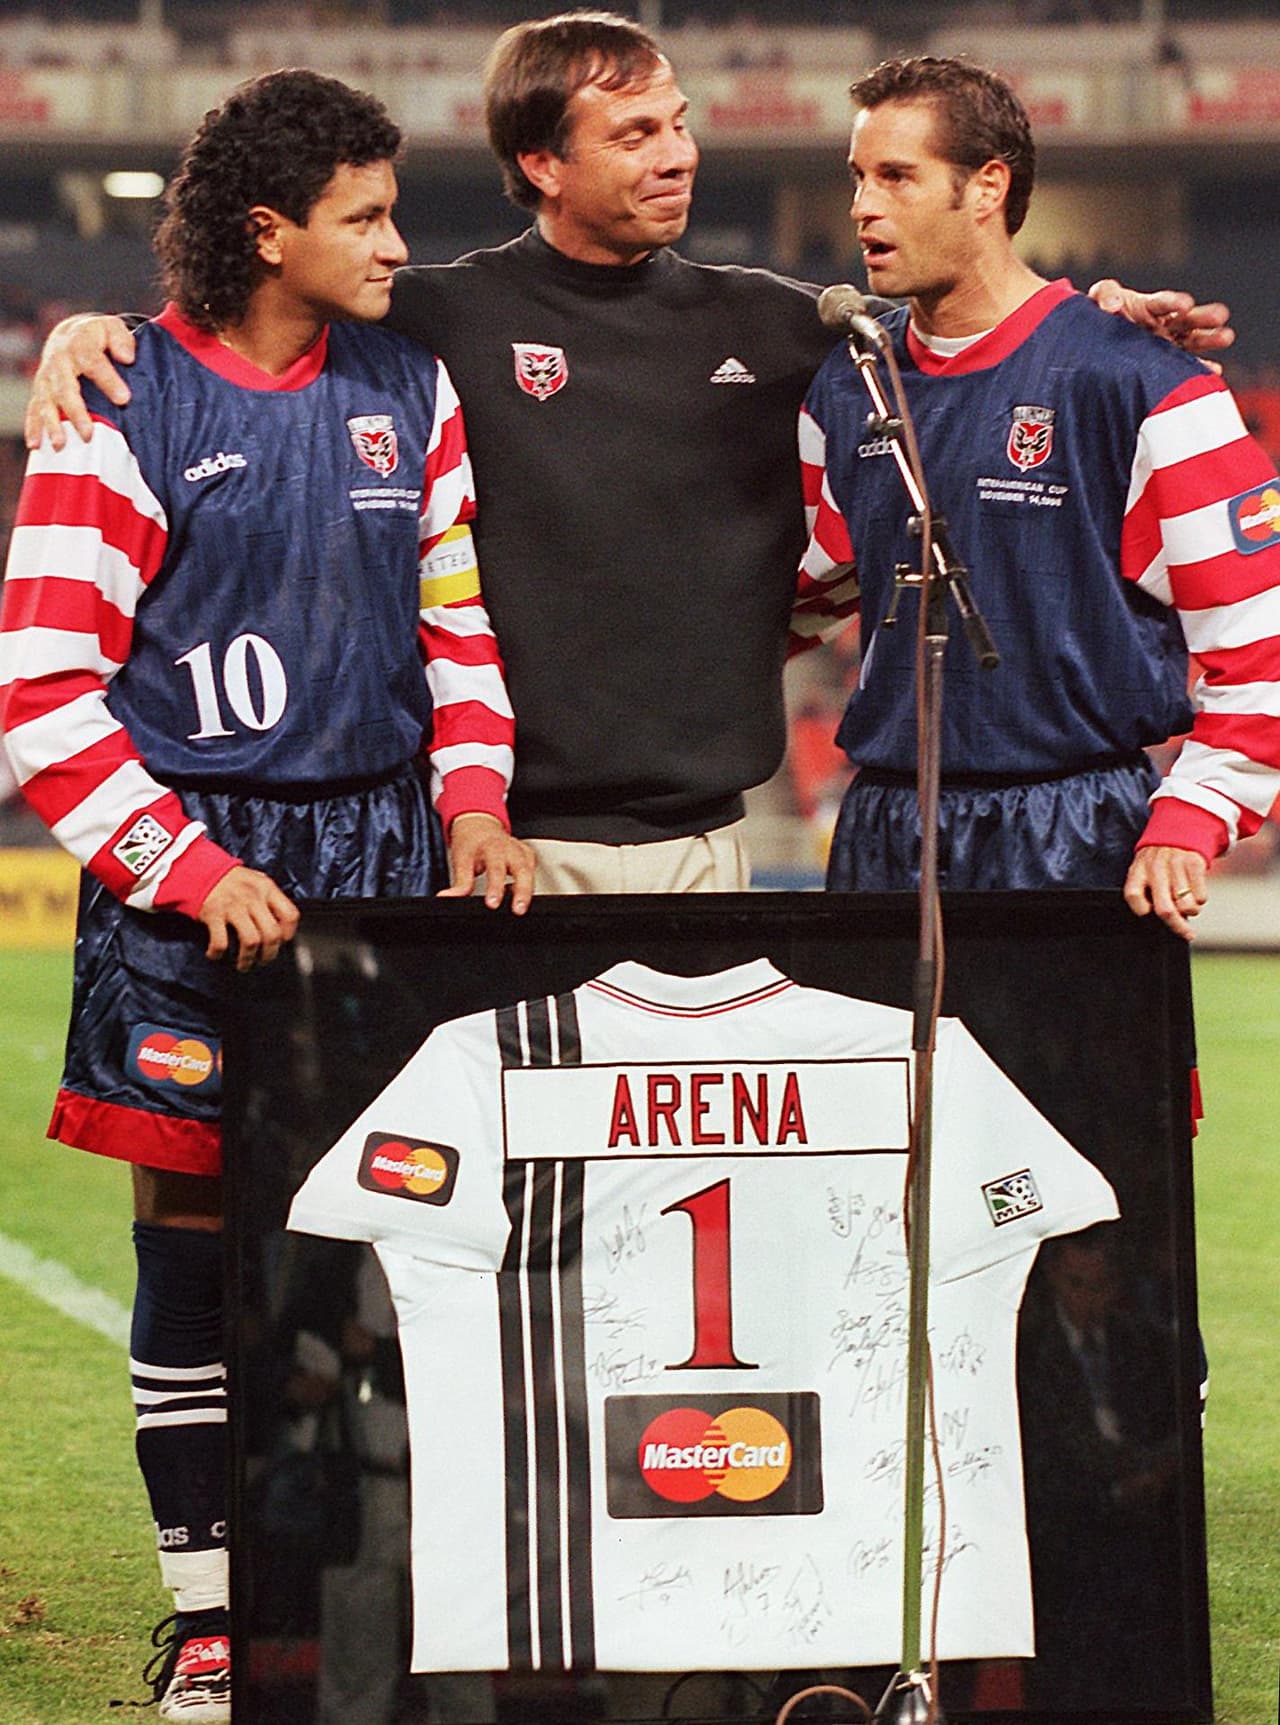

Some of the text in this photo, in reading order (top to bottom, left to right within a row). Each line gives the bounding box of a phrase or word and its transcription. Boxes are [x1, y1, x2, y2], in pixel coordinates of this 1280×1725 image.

[709, 373, 756, 384] adidas
[184, 452, 248, 482] adidas
[174, 633, 288, 740] 10
[137, 1046, 211, 1073] MasterCard
[607, 1071, 808, 1148] ARENA
[371, 1154, 445, 1182] MasterCard
[996, 1200, 1037, 1220] MLS
[660, 1177, 760, 1371] 1
[643, 1441, 787, 1470] MasterCard
